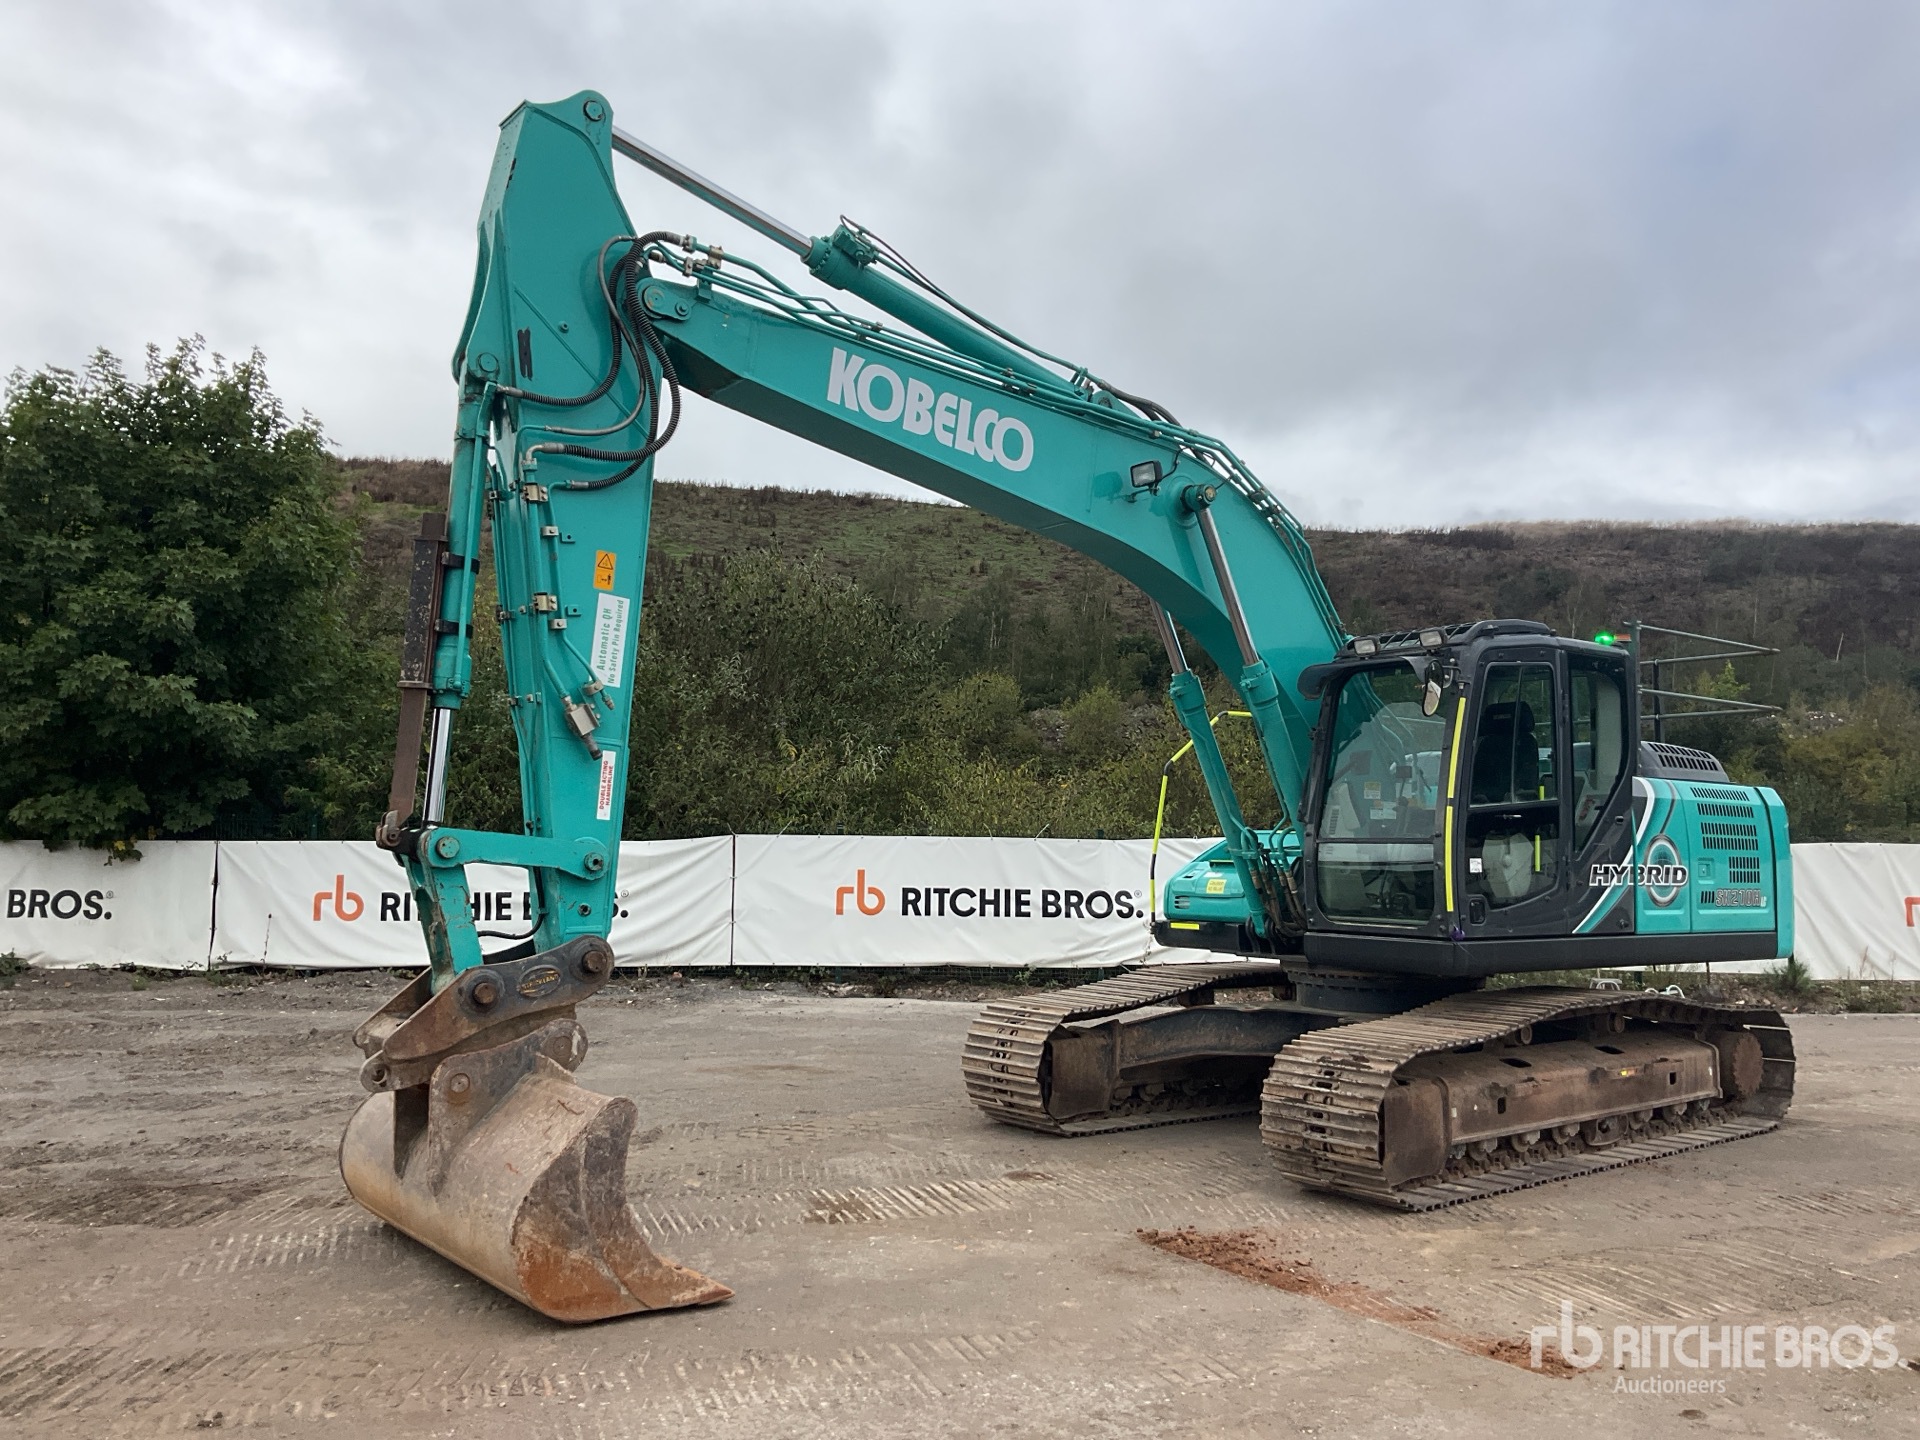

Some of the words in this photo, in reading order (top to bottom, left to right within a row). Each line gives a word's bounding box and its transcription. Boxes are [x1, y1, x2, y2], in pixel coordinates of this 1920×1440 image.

[827, 347, 1034, 472] KOBELCO
[602, 608, 613, 620] QH
[613, 600, 625, 632] Required
[596, 623, 611, 671] Automatic
[611, 634, 621, 646] Pin
[608, 648, 620, 672] Safety
[607, 674, 616, 684] No
[601, 760, 609, 784] ACTING
[605, 765, 614, 806] HAMMERLINE
[599, 784, 607, 810] DOUBLE
[1589, 863, 1689, 887] HYBRID
[6, 889, 113, 920] BROS.
[313, 874, 364, 922] rb
[835, 869, 886, 916] rb
[901, 887, 1031, 918] RITCHIE
[1042, 888, 1145, 919] BROS.
